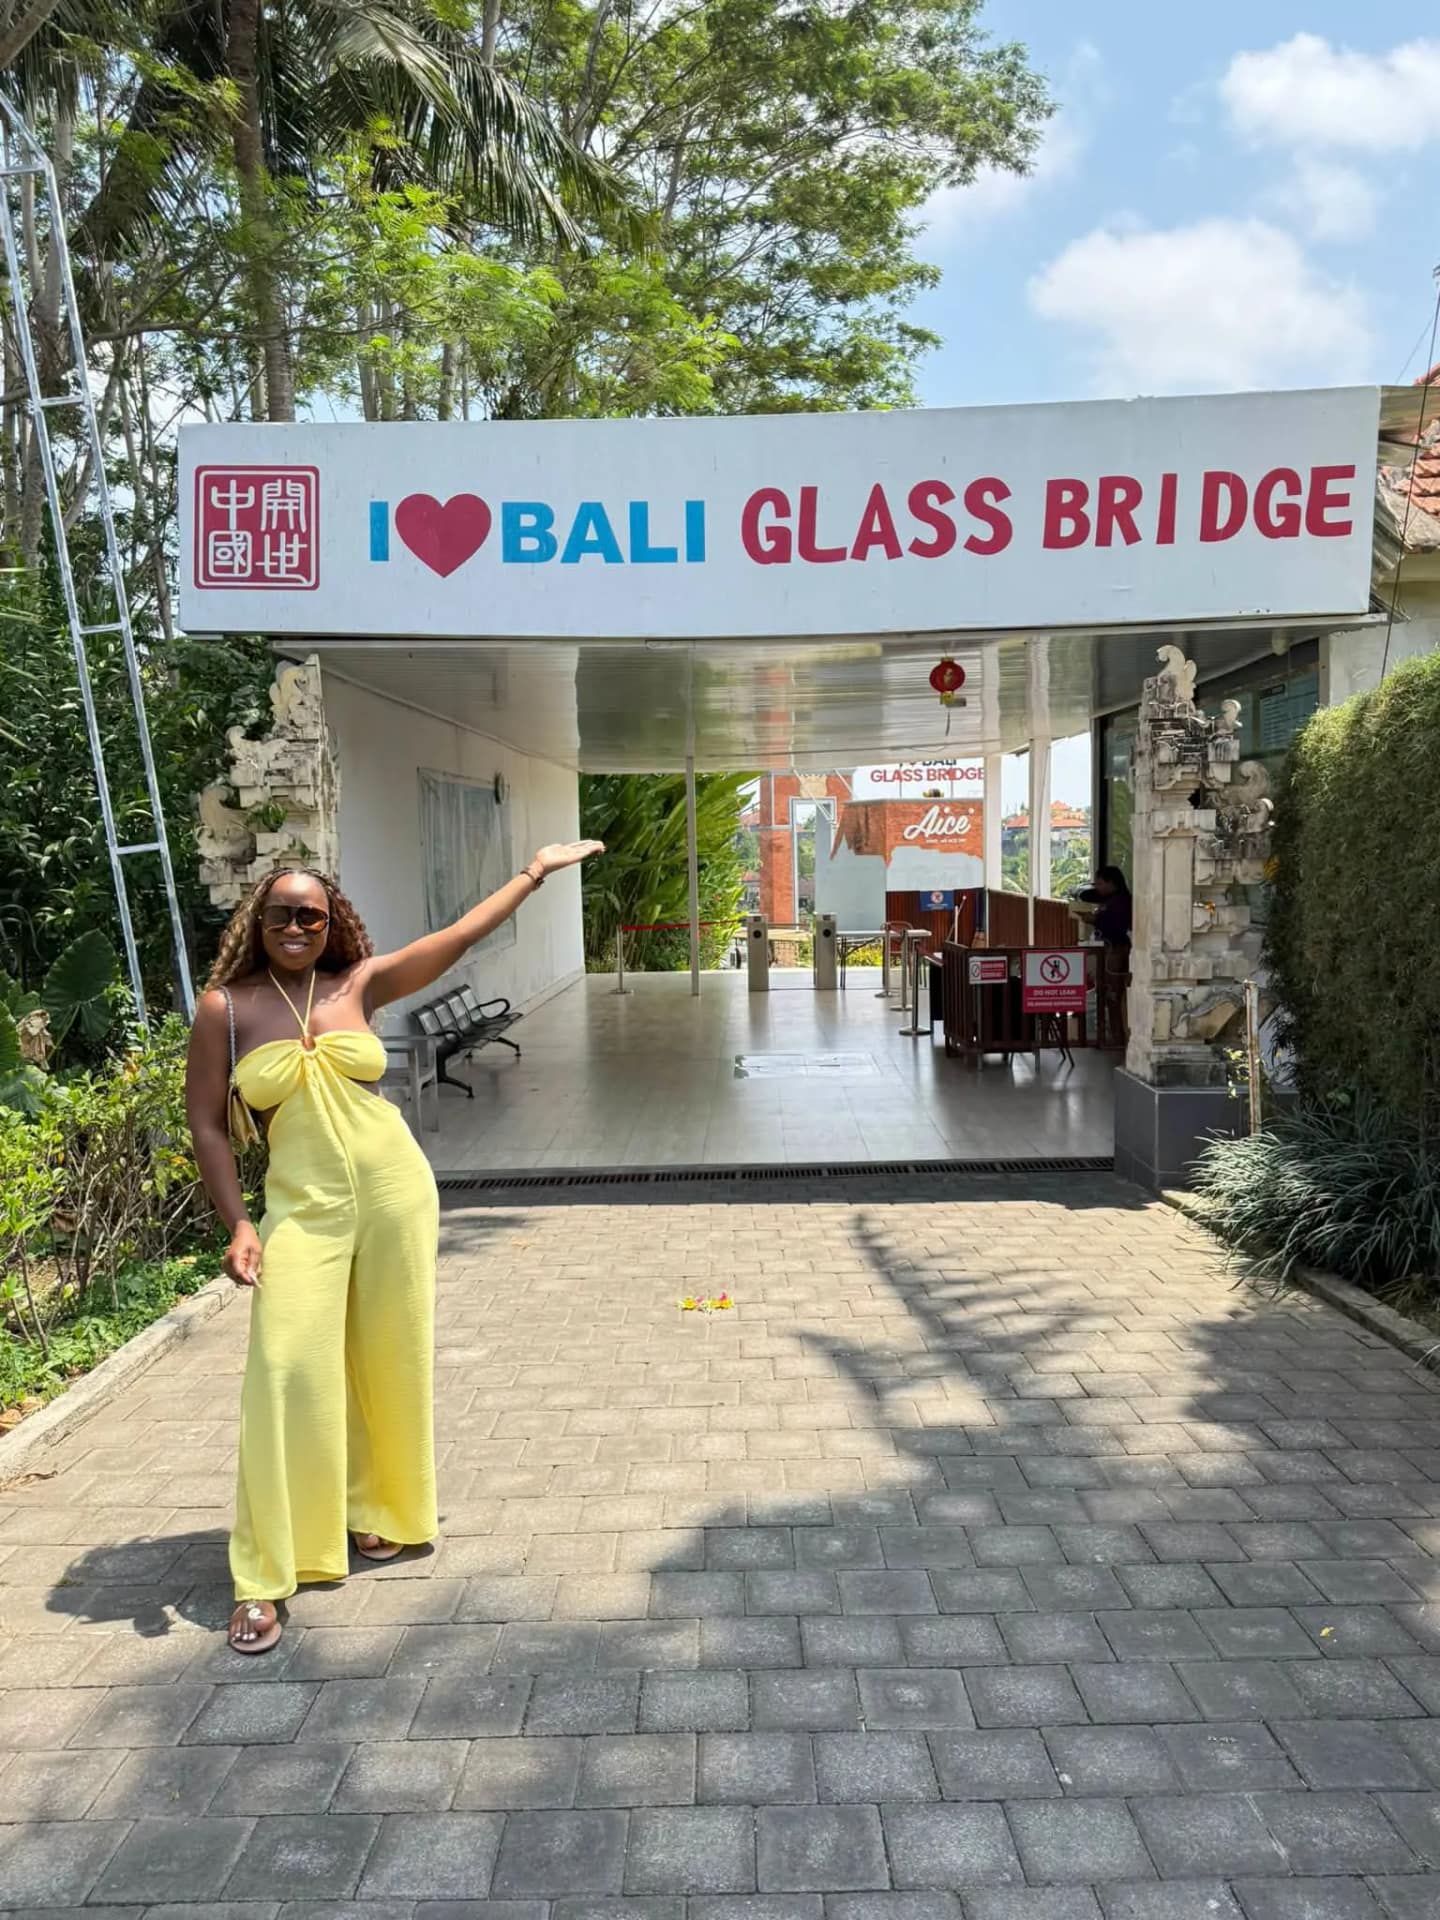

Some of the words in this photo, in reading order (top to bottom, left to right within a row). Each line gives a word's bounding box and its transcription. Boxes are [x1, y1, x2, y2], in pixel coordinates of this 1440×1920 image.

[369, 501, 389, 562] I
[501, 500, 706, 565] BALI
[741, 478, 1012, 565] GLASS
[1043, 465, 1356, 549] BRIDGE
[870, 769, 923, 782] GLASS
[903, 805, 972, 840] Aice
